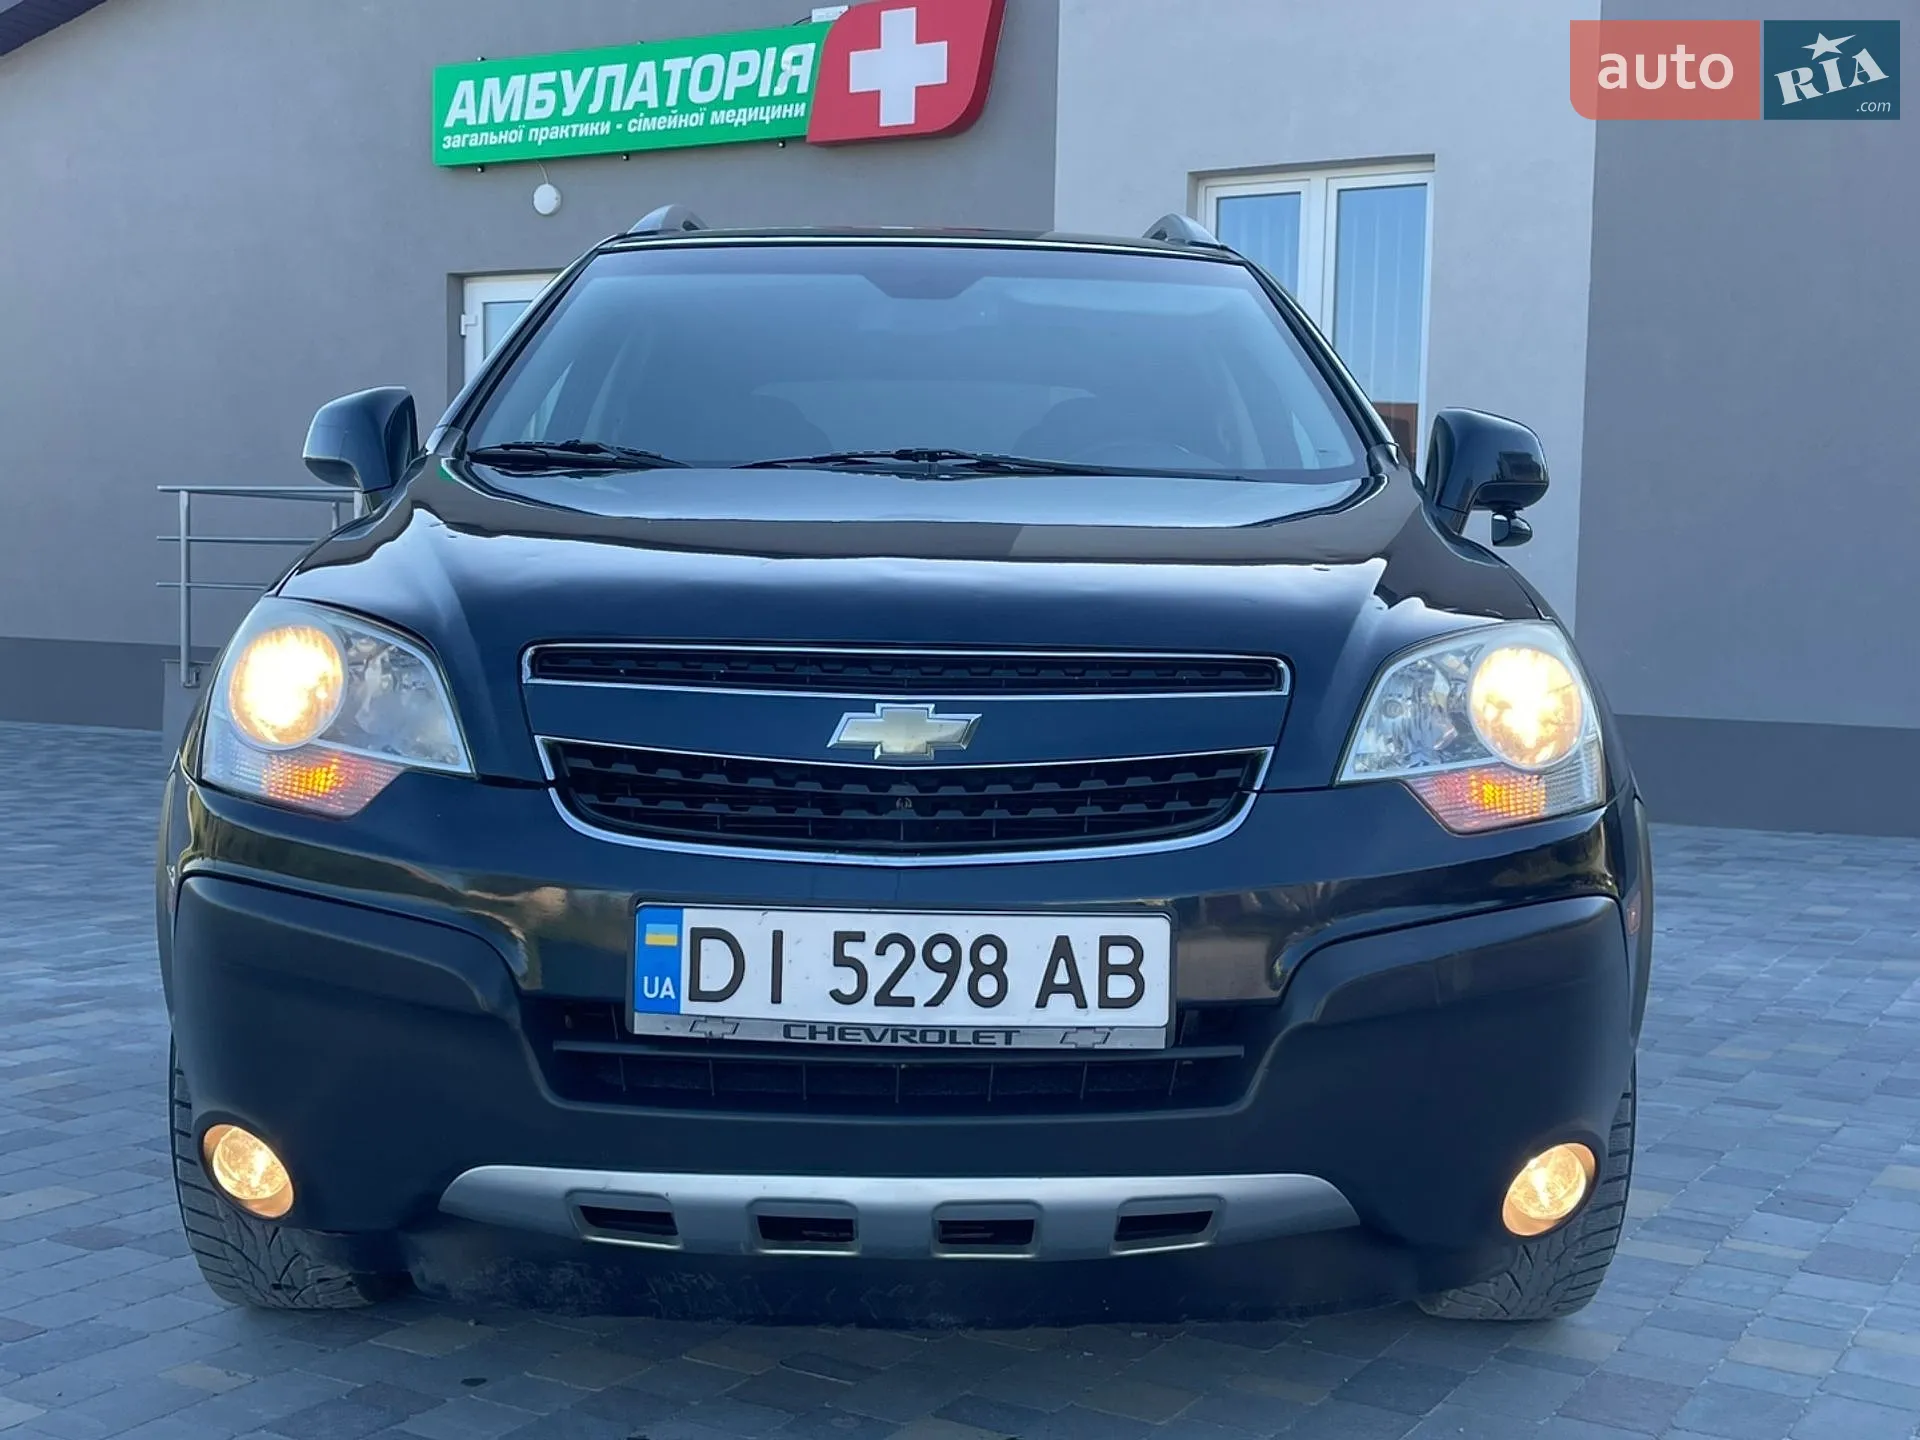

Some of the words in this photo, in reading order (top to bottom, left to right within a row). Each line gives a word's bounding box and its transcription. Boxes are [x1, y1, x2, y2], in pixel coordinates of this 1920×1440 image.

[443, 42, 818, 128] АМБУЛАТОРІЯ
[442, 124, 526, 149] загальної
[528, 120, 611, 146] практики
[627, 108, 707, 133] сімейної
[710, 102, 807, 127] медицини
[643, 975, 676, 1000] UA
[687, 926, 784, 1005] DI
[829, 930, 1009, 1009] 5298
[1034, 934, 1146, 1010] AB
[782, 1022, 1021, 1047] CHEVROLET
